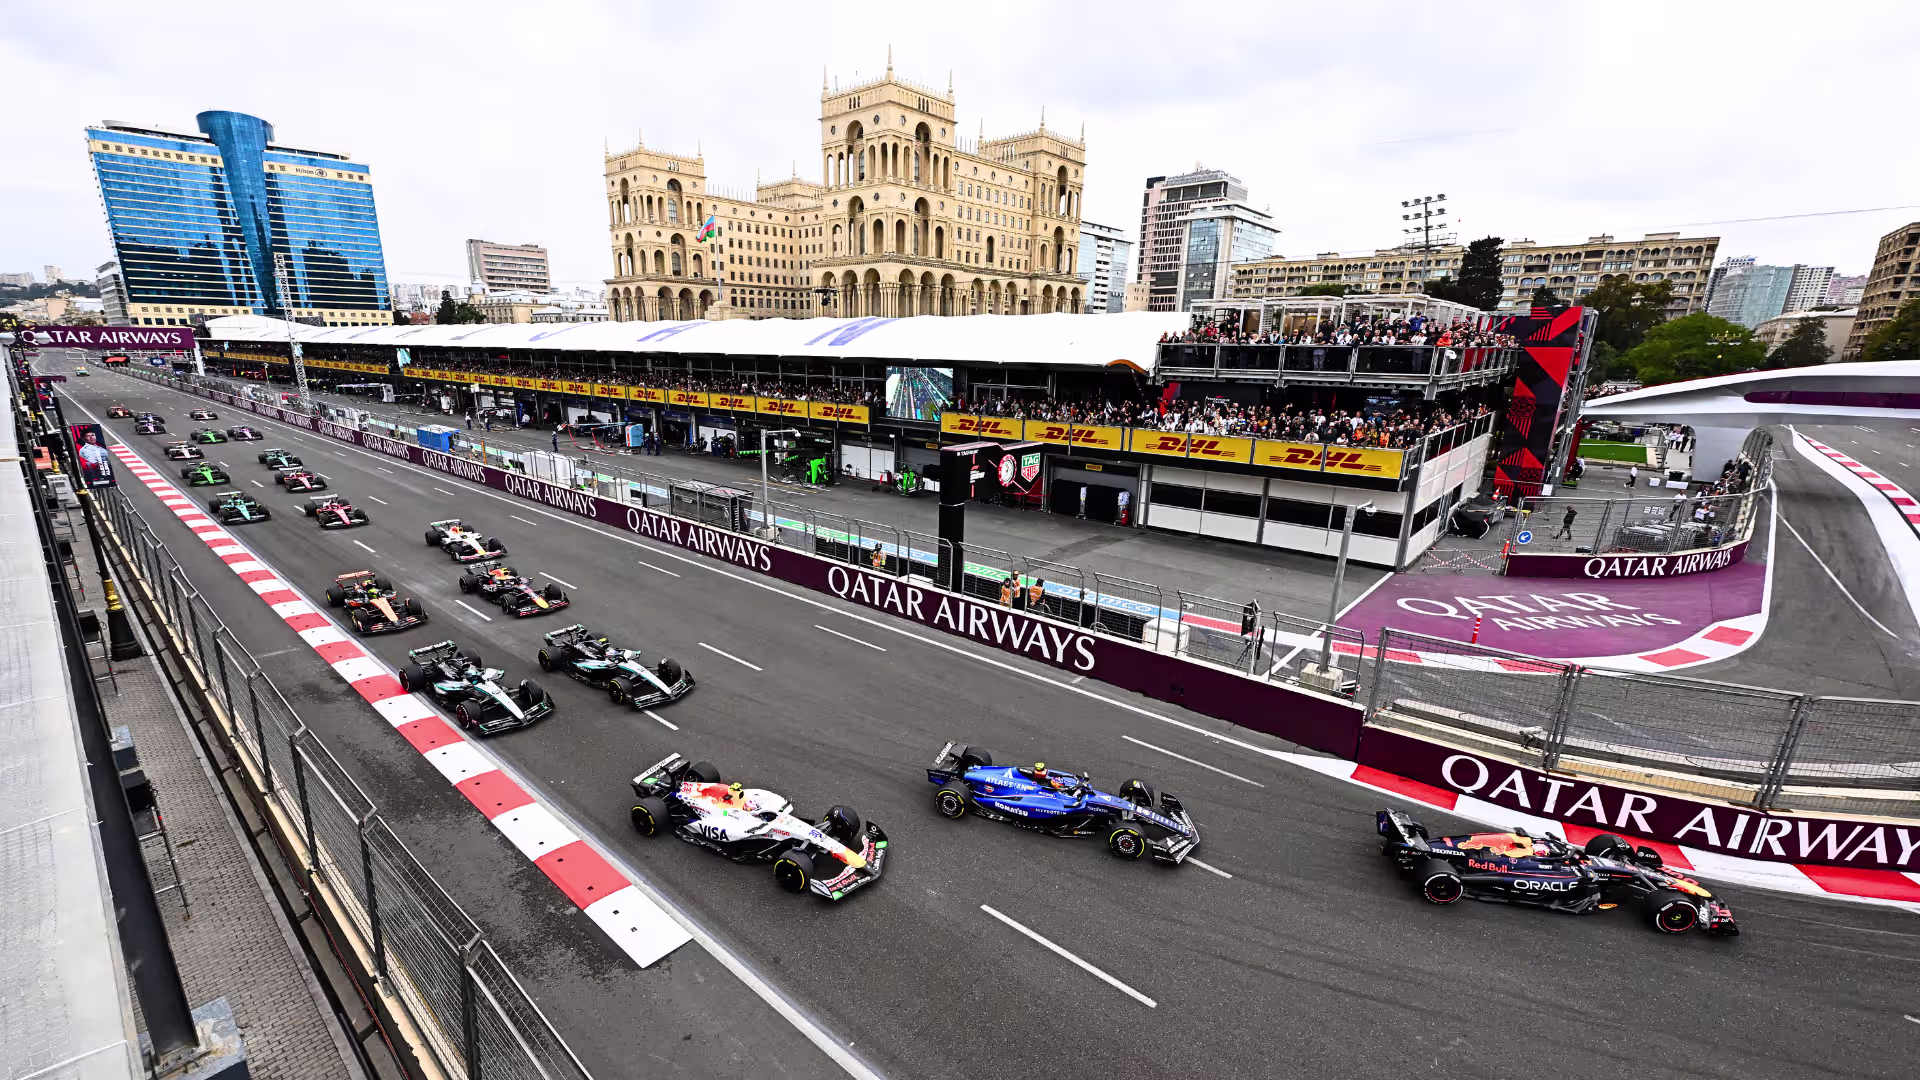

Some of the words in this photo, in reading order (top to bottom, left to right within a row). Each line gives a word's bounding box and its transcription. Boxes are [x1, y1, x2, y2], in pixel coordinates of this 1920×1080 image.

[100, 332, 182, 344] AIRWAYS
[542, 381, 556, 390] DHL
[568, 383, 584, 392] DHL
[601, 386, 618, 396] DHL
[636, 390, 656, 400] DHL
[677, 394, 699, 404] DHL
[720, 398, 744, 408] DHL
[768, 401, 796, 413] DHL
[822, 406, 854, 418] DHL
[958, 419, 1005, 434] DHL
[1044, 426, 1100, 444] DHL
[362, 434, 383, 451] QATAR
[383, 437, 409, 459] AIRWAYS
[1156, 436, 1222, 456] DHL
[422, 450, 449, 472] QATAR
[450, 460, 486, 483] AIRWAYS
[1024, 454, 1039, 466] TAG
[1283, 448, 1366, 470] DHL
[1022, 465, 1039, 478] HEUER
[505, 474, 541, 500] QATAR
[544, 485, 596, 518] AIRWAYS
[626, 508, 682, 545] QATAR
[686, 526, 771, 571] AIRWAYS
[1584, 557, 1667, 578] QATAR
[1671, 548, 1733, 574] AIRWAYS
[1396, 592, 1643, 620] QATAR
[828, 566, 924, 620] QATAR
[934, 596, 1095, 670] AIRWAYS
[1490, 612, 1682, 632] AIRWAYS
[985, 776, 1027, 792] ATLASSIAN
[1441, 754, 1658, 833] QATAR
[994, 801, 1028, 816] KOMATSU
[700, 824, 729, 841] VISA
[1432, 848, 1466, 857] HONDA
[1468, 859, 1488, 870] Red
[1489, 862, 1508, 873] Bull
[1514, 880, 1578, 892] ORACLE
